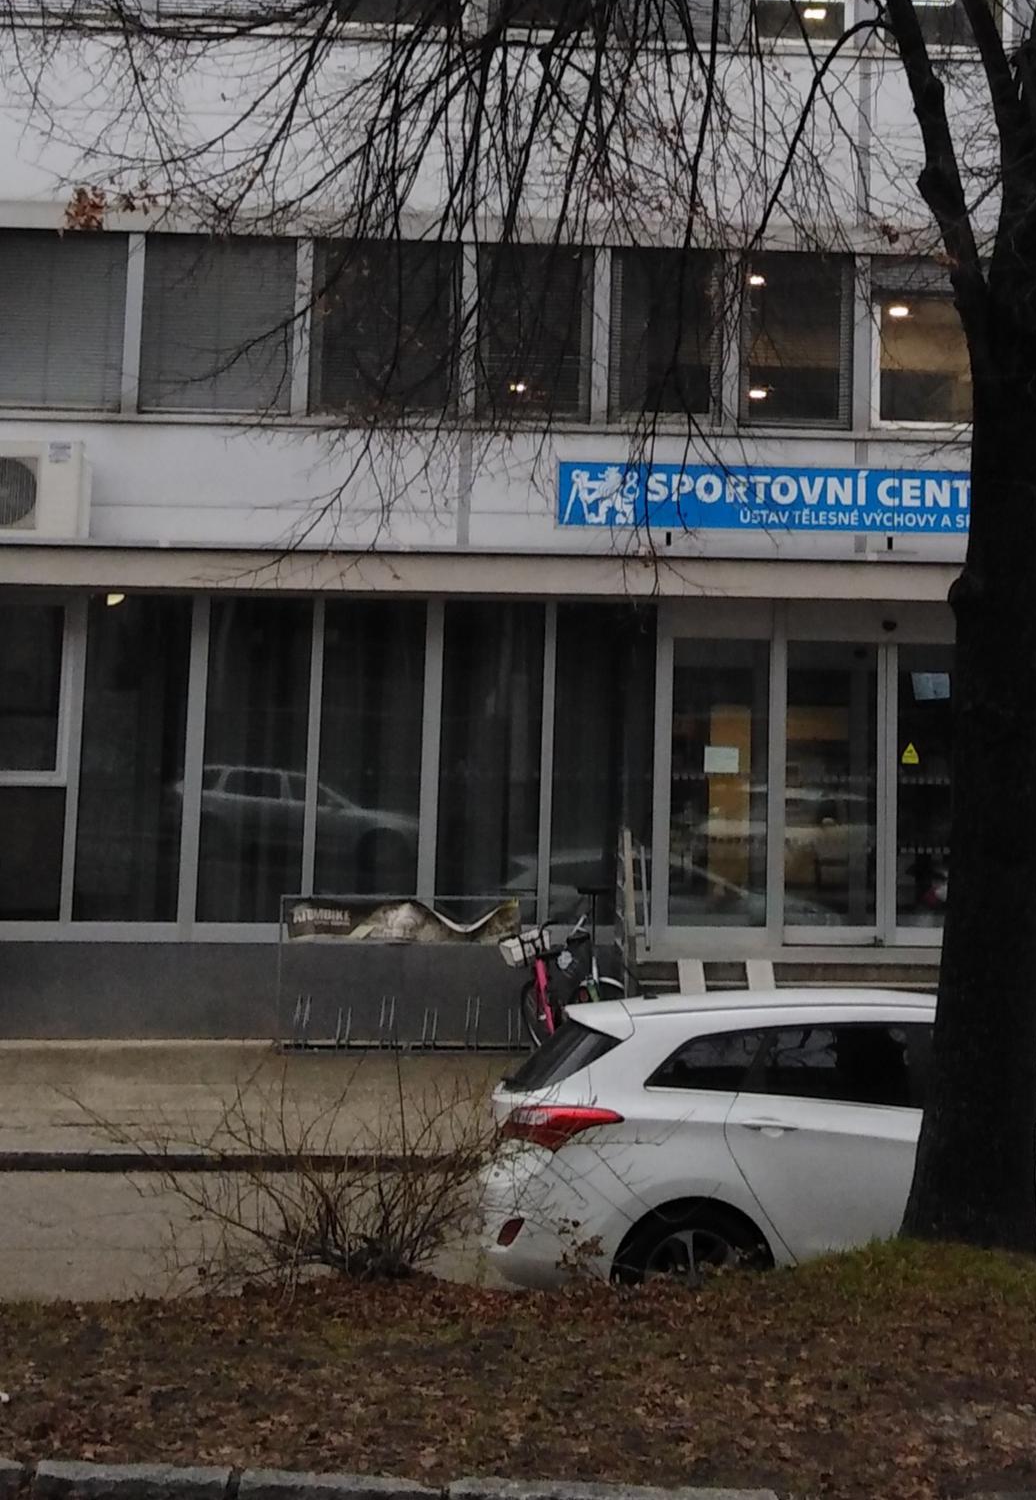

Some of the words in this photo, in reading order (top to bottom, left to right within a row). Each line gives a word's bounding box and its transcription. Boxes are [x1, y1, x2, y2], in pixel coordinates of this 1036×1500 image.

[646, 470, 869, 506] SPORTOVNÍ
[740, 508, 789, 525] ÚSTAV
[793, 508, 859, 526] TĚLESNÉ
[863, 509, 937, 527] VÝCHOVY
[941, 514, 952, 528] A
